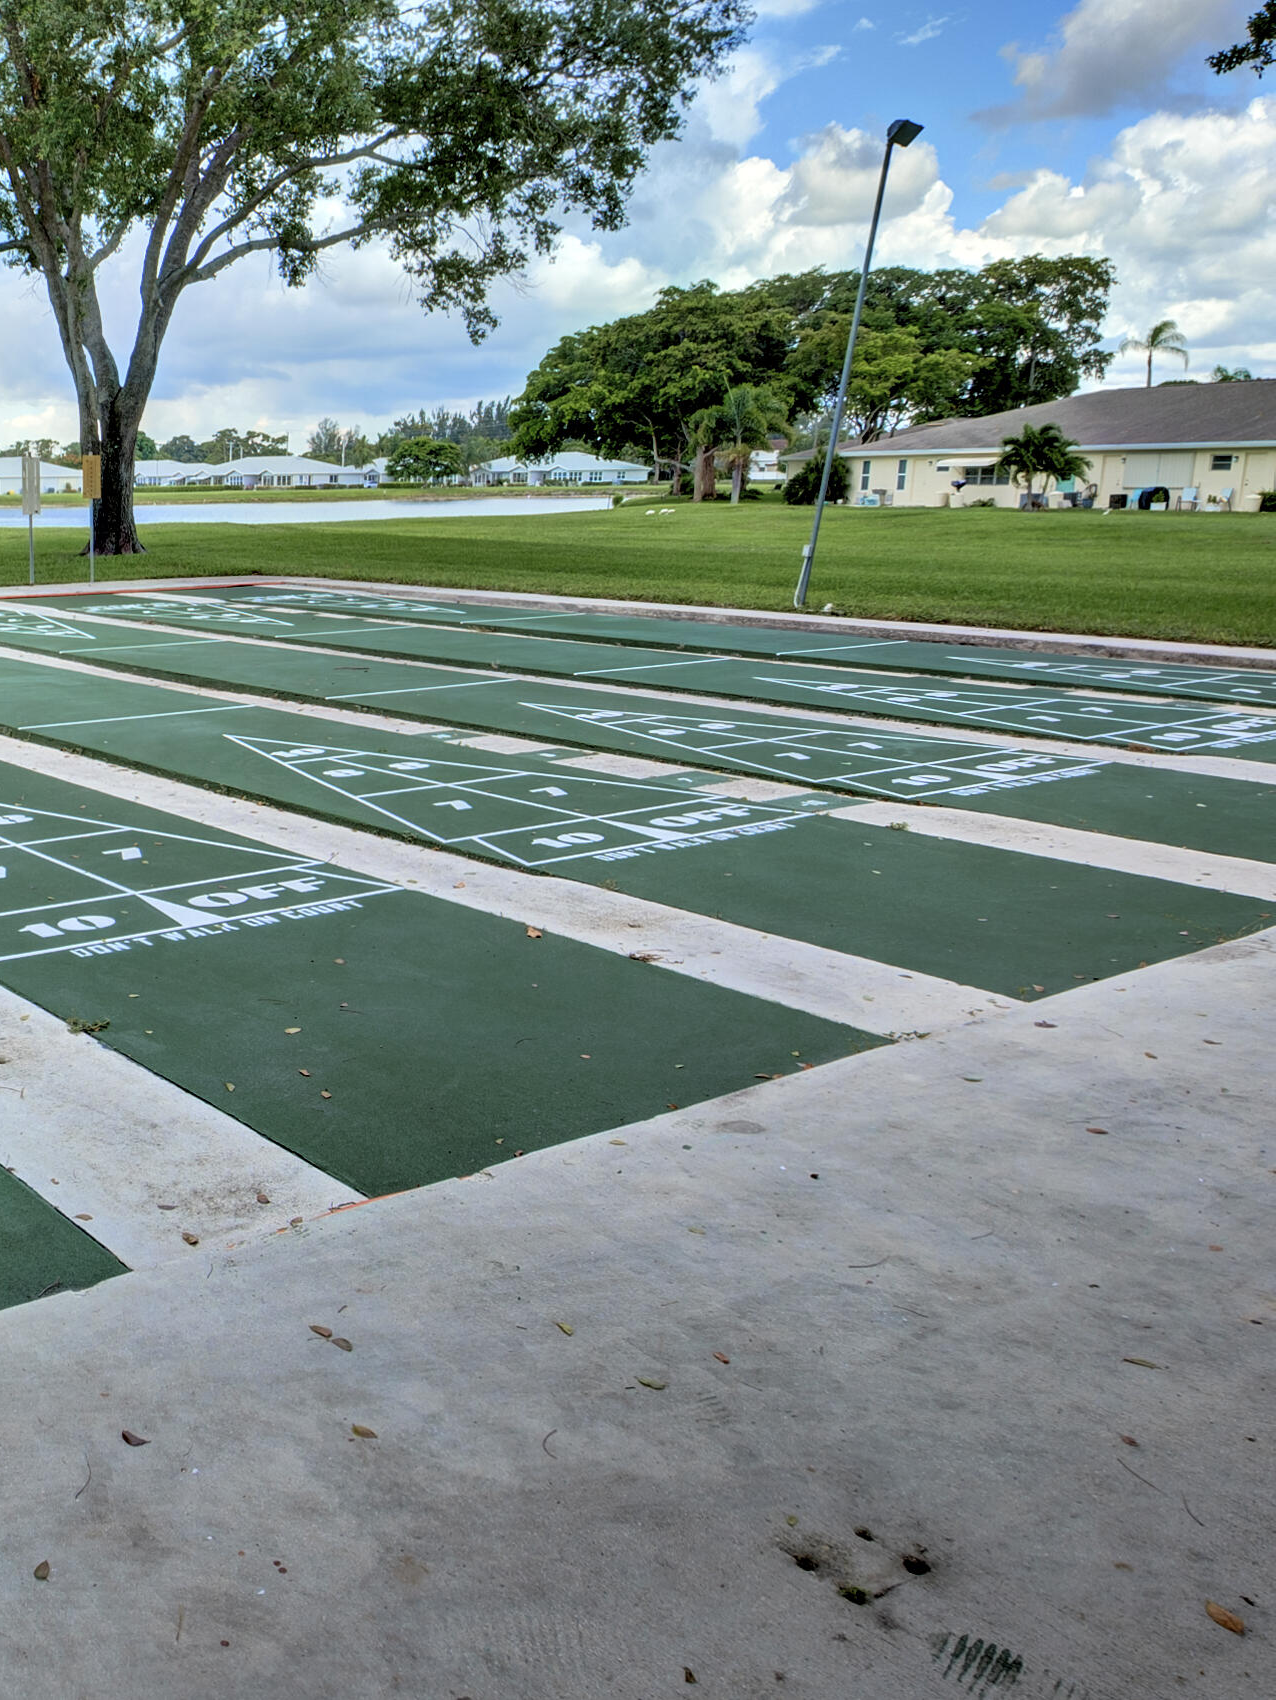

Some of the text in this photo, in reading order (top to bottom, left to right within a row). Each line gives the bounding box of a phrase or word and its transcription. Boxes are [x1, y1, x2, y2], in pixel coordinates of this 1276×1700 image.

[846, 741, 883, 750] 7
[774, 751, 811, 760] 7
[891, 774, 951, 786] 10
[976, 755, 1056, 772] OFF
[529, 786, 568, 797] 7
[432, 799, 473, 811] 7
[531, 804, 751, 849] 10 OFF
[102, 846, 143, 860] 7
[18, 876, 326, 938] 10 OFF
[69, 900, 364, 958] DON'T WALK ON COURT
